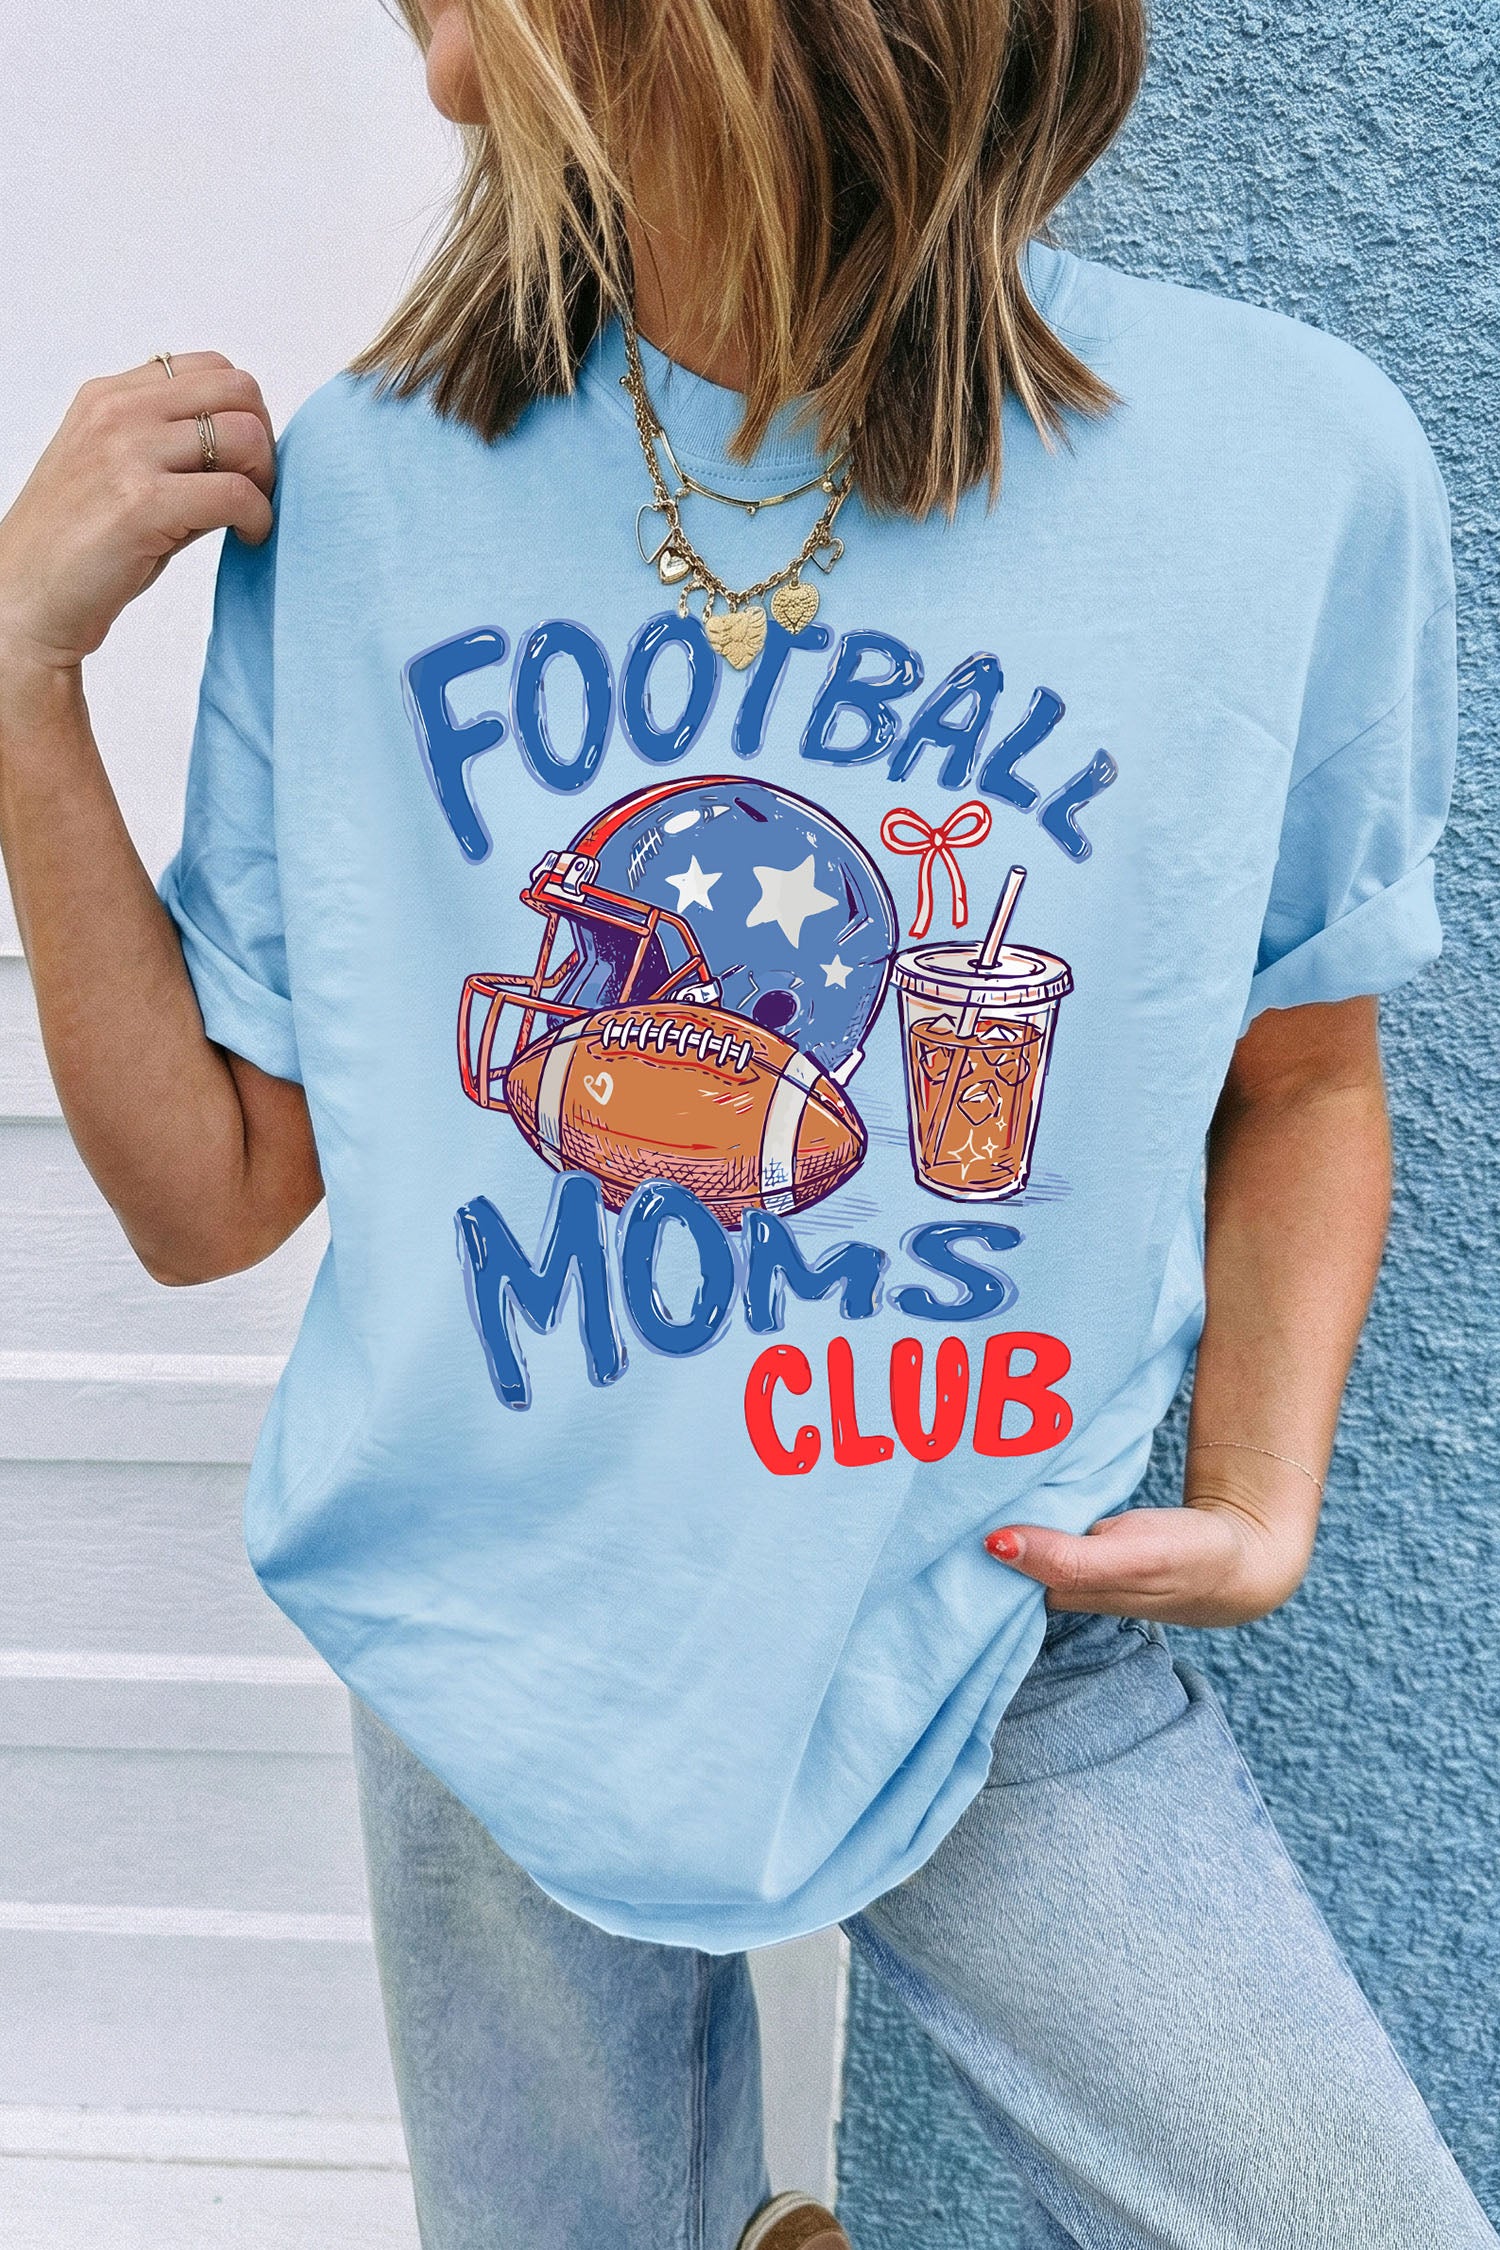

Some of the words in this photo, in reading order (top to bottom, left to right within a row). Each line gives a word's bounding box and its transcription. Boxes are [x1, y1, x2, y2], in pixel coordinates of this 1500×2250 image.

[403, 613, 1119, 865] FOOTBALL
[455, 1171, 1027, 1412] MOMS
[744, 1331, 1074, 1476] CLUB
